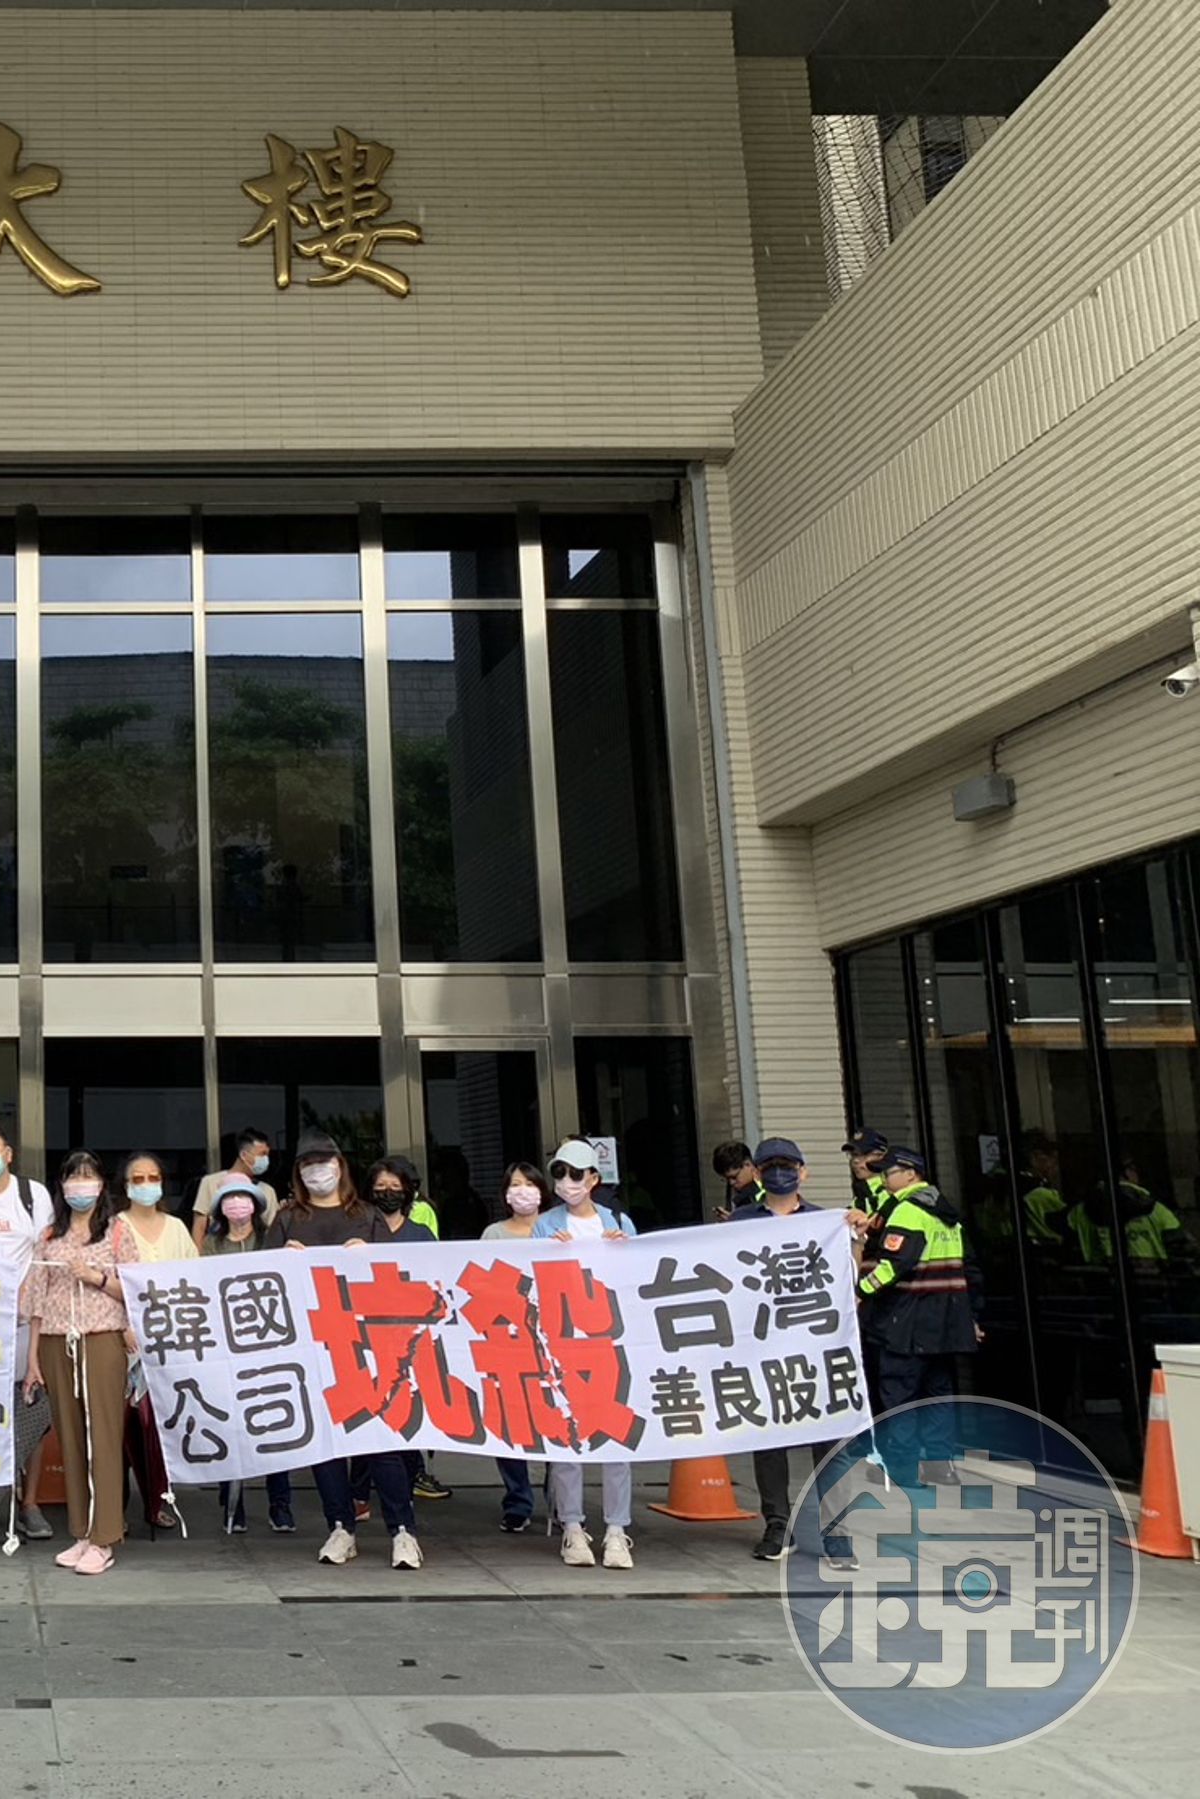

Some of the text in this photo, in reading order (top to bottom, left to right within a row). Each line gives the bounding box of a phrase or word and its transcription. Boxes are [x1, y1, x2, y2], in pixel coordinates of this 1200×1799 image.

[138, 1271, 296, 1366] 韓國
[639, 1238, 840, 1352] 台灣
[307, 1259, 645, 1453] 坑殺
[651, 1347, 863, 1438] 善良股民
[164, 1363, 315, 1463] 公司
